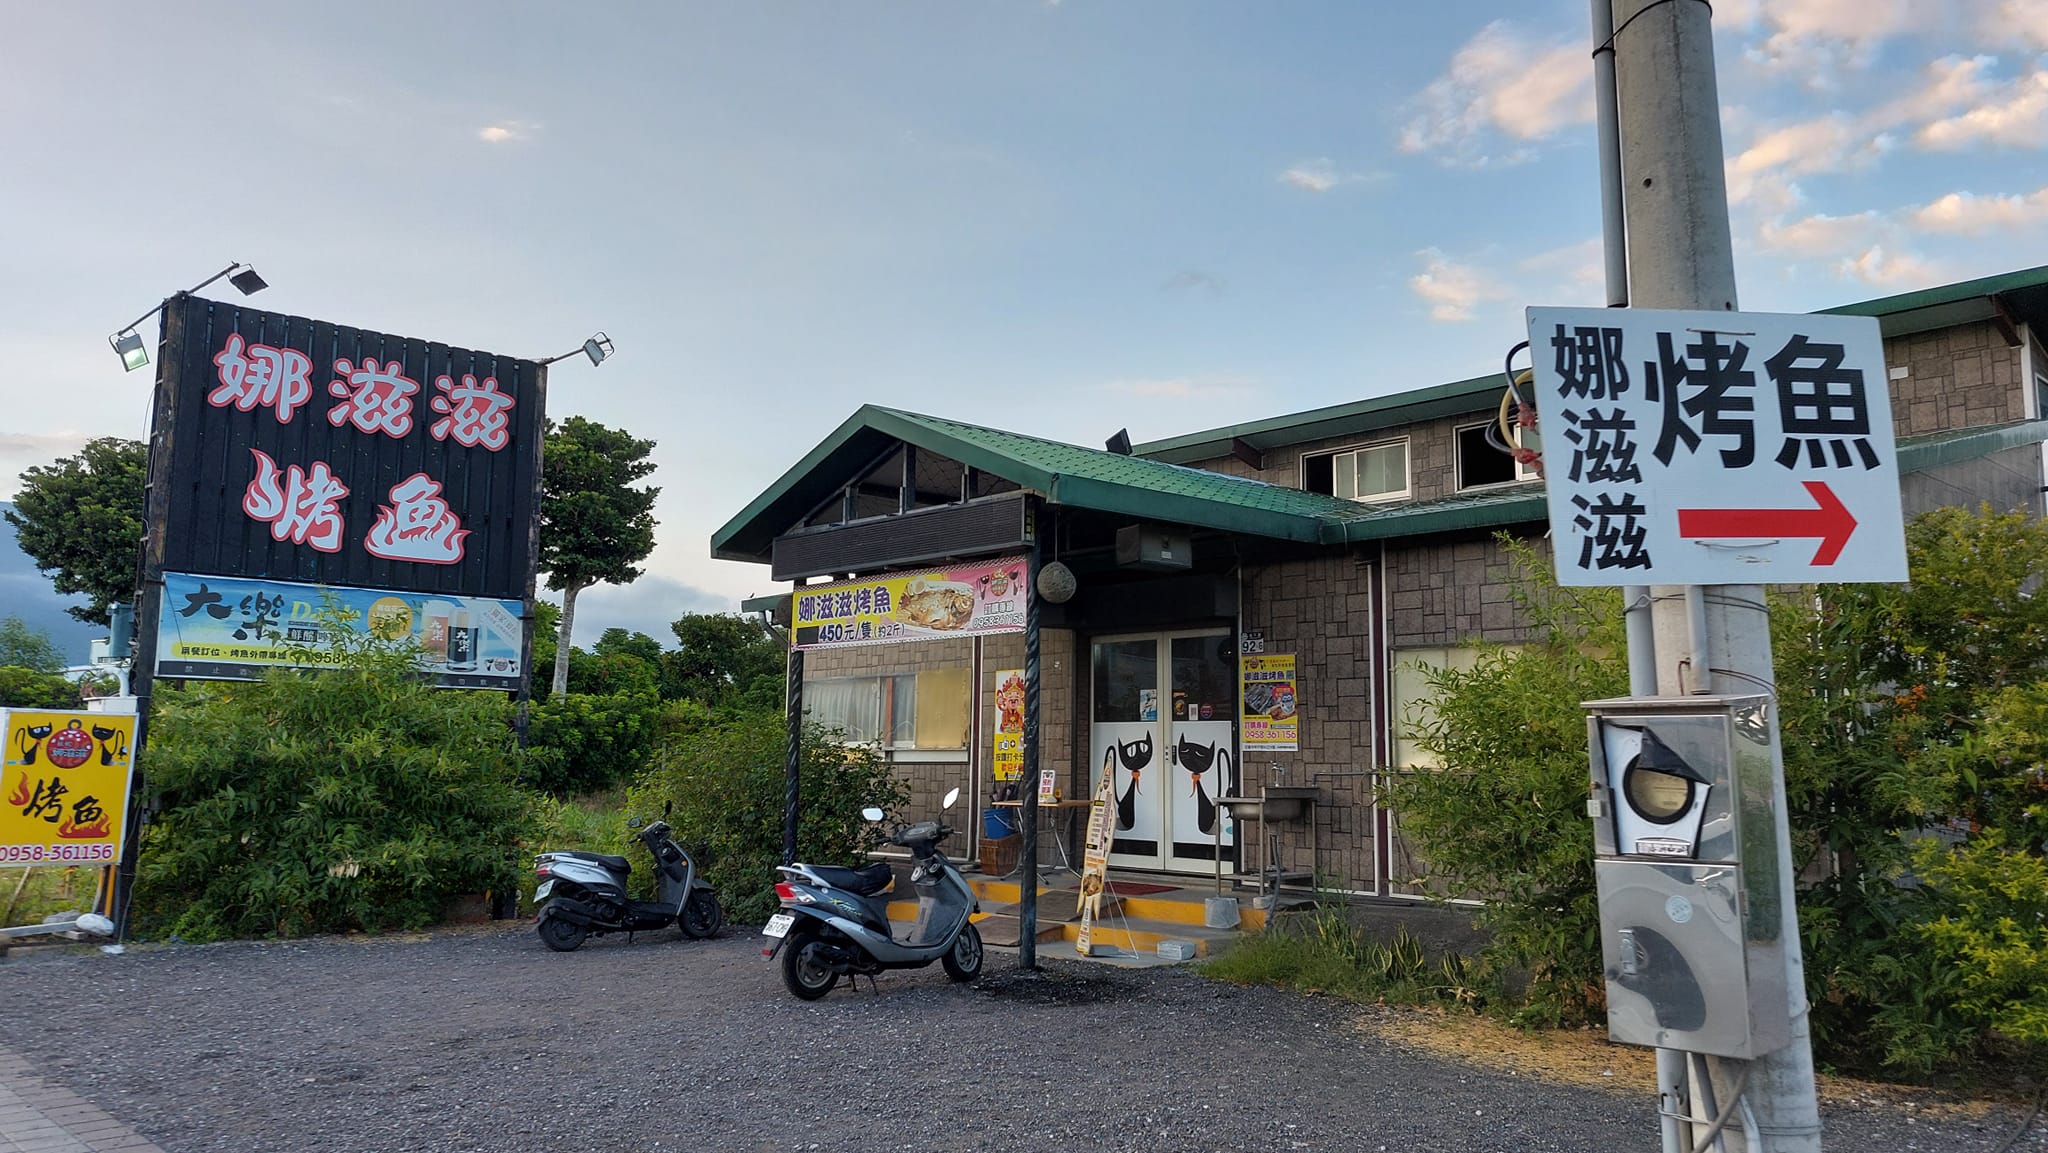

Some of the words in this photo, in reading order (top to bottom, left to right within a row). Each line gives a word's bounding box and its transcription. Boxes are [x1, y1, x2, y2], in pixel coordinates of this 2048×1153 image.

[208, 333, 516, 452] 娜滋滋
[1644, 331, 1881, 471] 烤魚
[1551, 324, 1653, 571] 娜滋滋
[798, 586, 892, 622] 娜滋滋烤魚
[1244, 730, 1265, 739] 0958
[1266, 730, 1280, 739] 361
[1282, 730, 1297, 739] 156
[0, 844, 113, 862] 0958-361156
